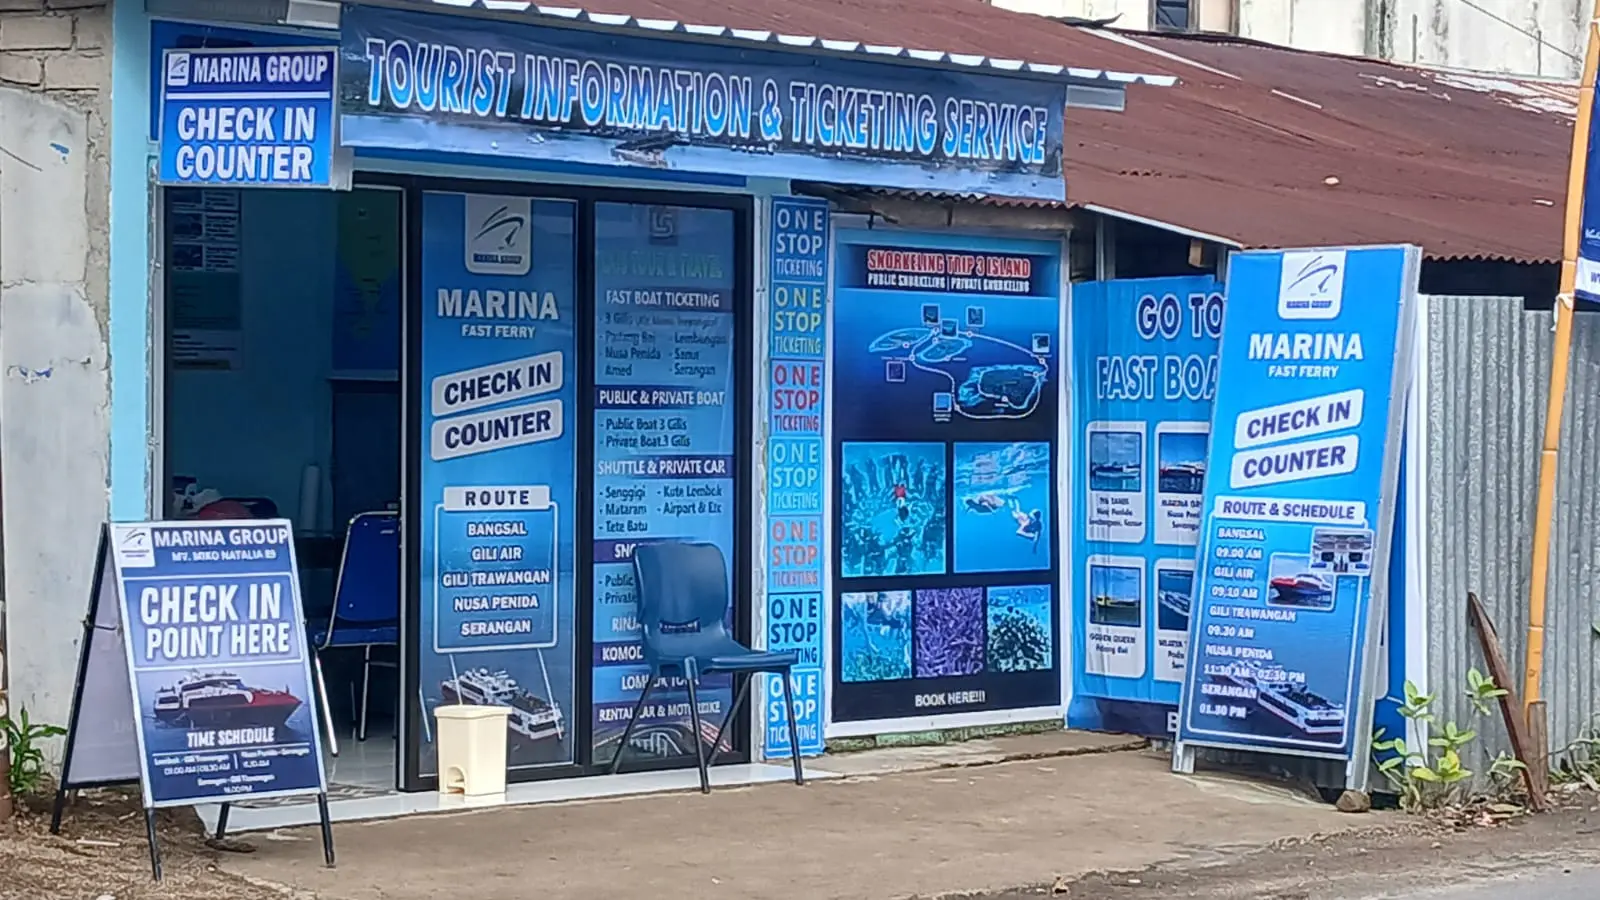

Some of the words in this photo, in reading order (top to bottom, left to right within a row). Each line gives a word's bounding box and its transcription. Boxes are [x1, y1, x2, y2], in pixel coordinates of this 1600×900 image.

[194, 56, 261, 83] MARINA
[266, 55, 328, 82] GROUP
[366, 38, 516, 118] TOURIST
[521, 53, 750, 140] INFORMATION
[759, 79, 782, 142] &
[789, 81, 938, 156] TICKETING
[942, 97, 1048, 165] SERVICE
[178, 107, 275, 141] CHECK
[284, 107, 316, 141] IN
[176, 145, 312, 179] COUNTER
[777, 208, 823, 232] ONE
[776, 233, 822, 256] STOP
[776, 258, 823, 277] TICKETING
[867, 250, 945, 274] SNORKELING
[945, 254, 974, 276] TRIP
[975, 255, 986, 277] 3
[986, 256, 1031, 279] ISLAND
[868, 273, 896, 286] PUBLIC
[951, 278, 982, 291] PRIVATE
[437, 288, 559, 320] MARINA
[606, 290, 632, 304] FAST
[634, 291, 662, 305] BOAT
[665, 292, 720, 307] TICKETING
[775, 286, 822, 309] ONE
[774, 311, 821, 333] STOP
[1136, 293, 1182, 339] GO
[1188, 292, 1225, 338] TO
[461, 324, 492, 337] FAST
[495, 325, 536, 338] FERRY
[775, 336, 821, 355] TICKETING
[1248, 333, 1364, 360] MARINA
[774, 364, 820, 387] ONE
[1096, 355, 1159, 400] FAST
[1268, 365, 1298, 377] FAST
[1299, 365, 1339, 378] FERRY
[444, 368, 522, 405] CHECK
[528, 361, 552, 388] IN
[600, 390, 638, 405] PUBLIC
[640, 390, 650, 405] &
[652, 391, 695, 406] PRIVATE
[697, 391, 725, 406] BOAT
[774, 389, 819, 411] STOP
[605, 418, 634, 430] Public
[636, 418, 658, 430] Boat
[660, 419, 665, 430] 3
[774, 415, 819, 432] TICKETING
[1247, 406, 1320, 439] CHECK
[1327, 399, 1351, 423] IN
[444, 409, 551, 449] COUNTER
[605, 433, 638, 447] Private
[640, 435, 660, 447] Boat
[773, 443, 818, 464] ONE
[1243, 445, 1346, 479] COUNTER
[598, 460, 645, 475] SHUTTLE
[647, 459, 657, 474] &
[660, 459, 702, 474] PRIVATE
[704, 459, 726, 474] CAR
[772, 467, 817, 489] STOP
[465, 490, 530, 506] ROUTE
[605, 484, 645, 501] Senggigi
[773, 492, 817, 509] TICKETING
[663, 502, 697, 518] Airport
[1223, 501, 1266, 515] ROUTE
[1268, 503, 1279, 515] &
[1282, 503, 1355, 519] SCHEDULE
[154, 529, 225, 547] MARINA
[229, 527, 288, 545] GROUP
[467, 522, 527, 536] BANGSAL
[772, 520, 817, 542] ONE
[1217, 527, 1264, 540] BANGSAL
[193, 551, 219, 561] MIKO
[221, 550, 263, 561] NATALIA
[472, 548, 499, 561] GILI
[500, 547, 522, 560] AIR
[772, 546, 817, 566] STOP
[1245, 549, 1262, 559] AM
[442, 573, 468, 587] GILI
[471, 570, 550, 586] TRAWANGAN
[605, 575, 634, 587] Public
[772, 570, 817, 587] TICKETING
[1214, 566, 1233, 577] GILI
[1235, 568, 1253, 579] AIR
[1241, 588, 1258, 599] AM
[140, 583, 240, 625] CHECK
[249, 583, 281, 620] IN
[454, 597, 489, 611] NUSA
[492, 595, 539, 609] PENIDA
[771, 598, 817, 620] ONE
[1209, 605, 1230, 616] GILI
[1232, 606, 1296, 621] TRAWANGAN
[461, 620, 531, 636] SERANGAN
[771, 622, 817, 644] STOP
[1237, 627, 1254, 638] AM
[146, 625, 224, 660] POINT
[231, 622, 290, 655] HERE
[1205, 644, 1234, 657] NUSA
[1235, 647, 1273, 660] PENIDA
[1232, 666, 1249, 678] AM
[1288, 671, 1305, 683] PM
[770, 674, 816, 698] ONE
[1201, 683, 1257, 699] SERANGAN
[915, 693, 946, 707] BOOK
[657, 705, 666, 717] &
[1229, 706, 1246, 718] PM
[186, 730, 216, 748] TIME
[218, 727, 275, 745] SCHEDULE
